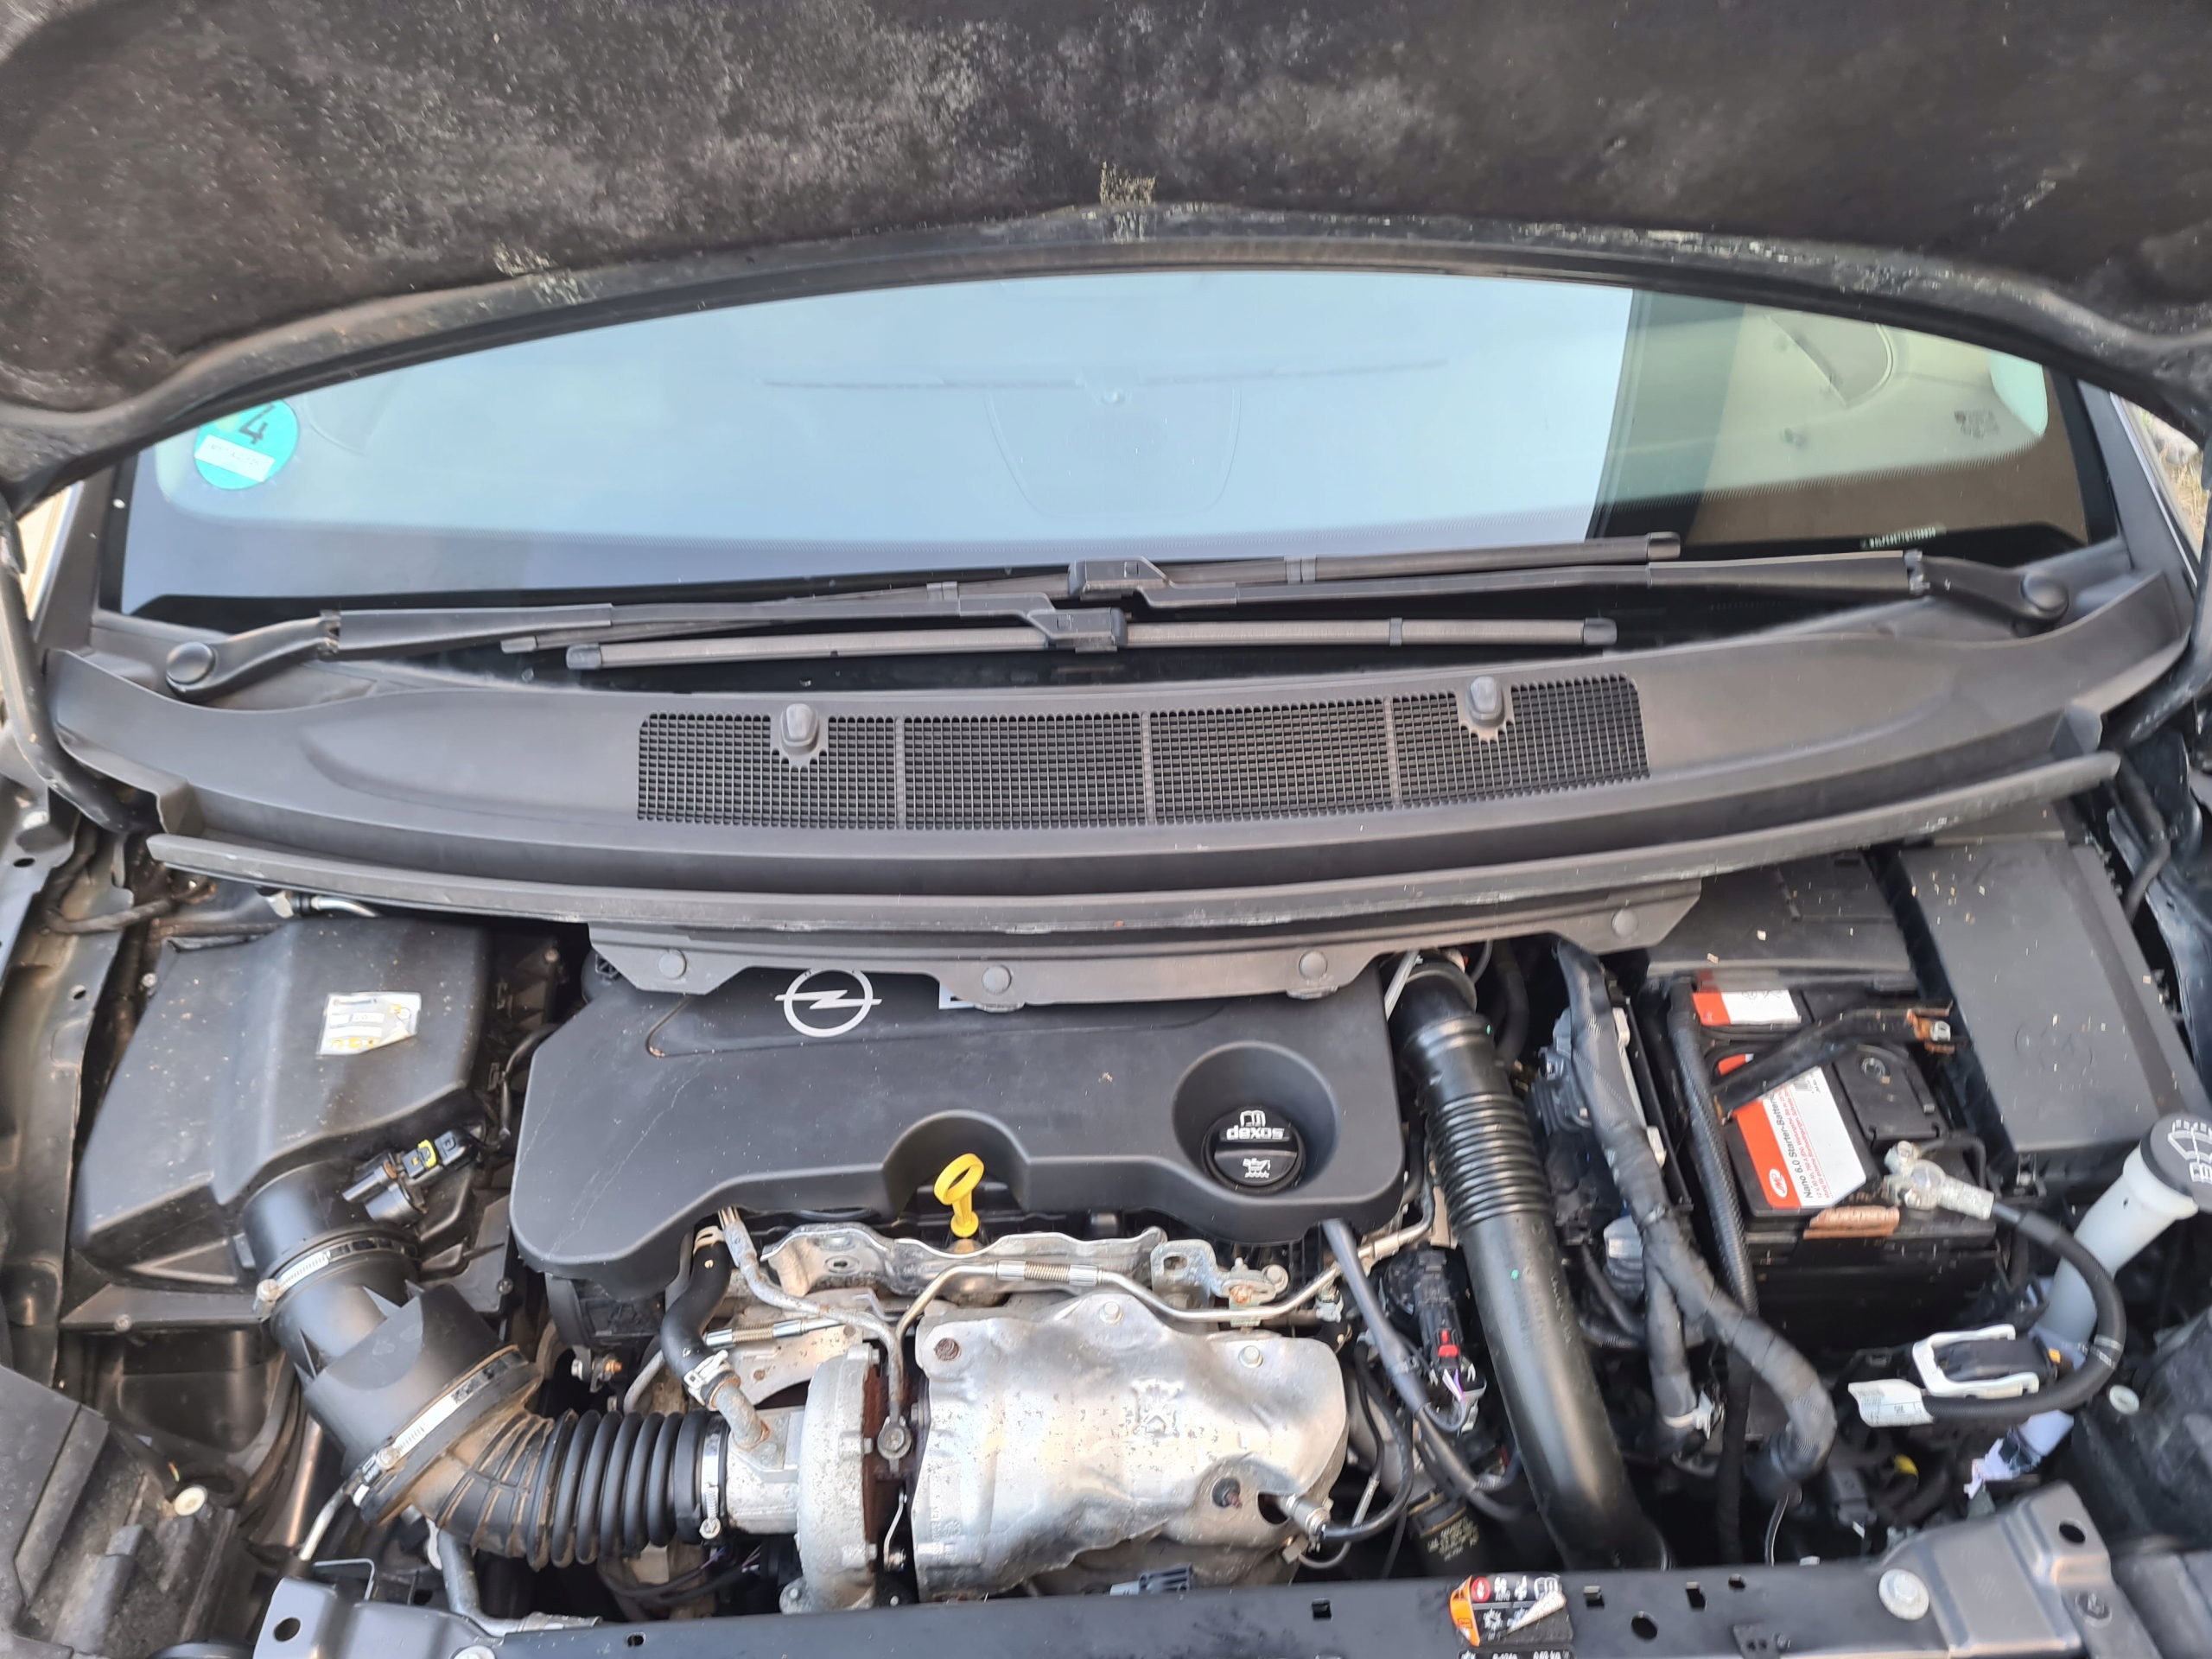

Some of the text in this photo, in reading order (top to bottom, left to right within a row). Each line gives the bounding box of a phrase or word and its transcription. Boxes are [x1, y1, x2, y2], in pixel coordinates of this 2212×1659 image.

[238, 404, 275, 444] 4
[1227, 1125, 1284, 1141] dexos
[1794, 1160, 1803, 1172] 6.0
[1770, 1173, 1785, 1193] JMP
[1800, 1176, 1813, 1198] Nano
